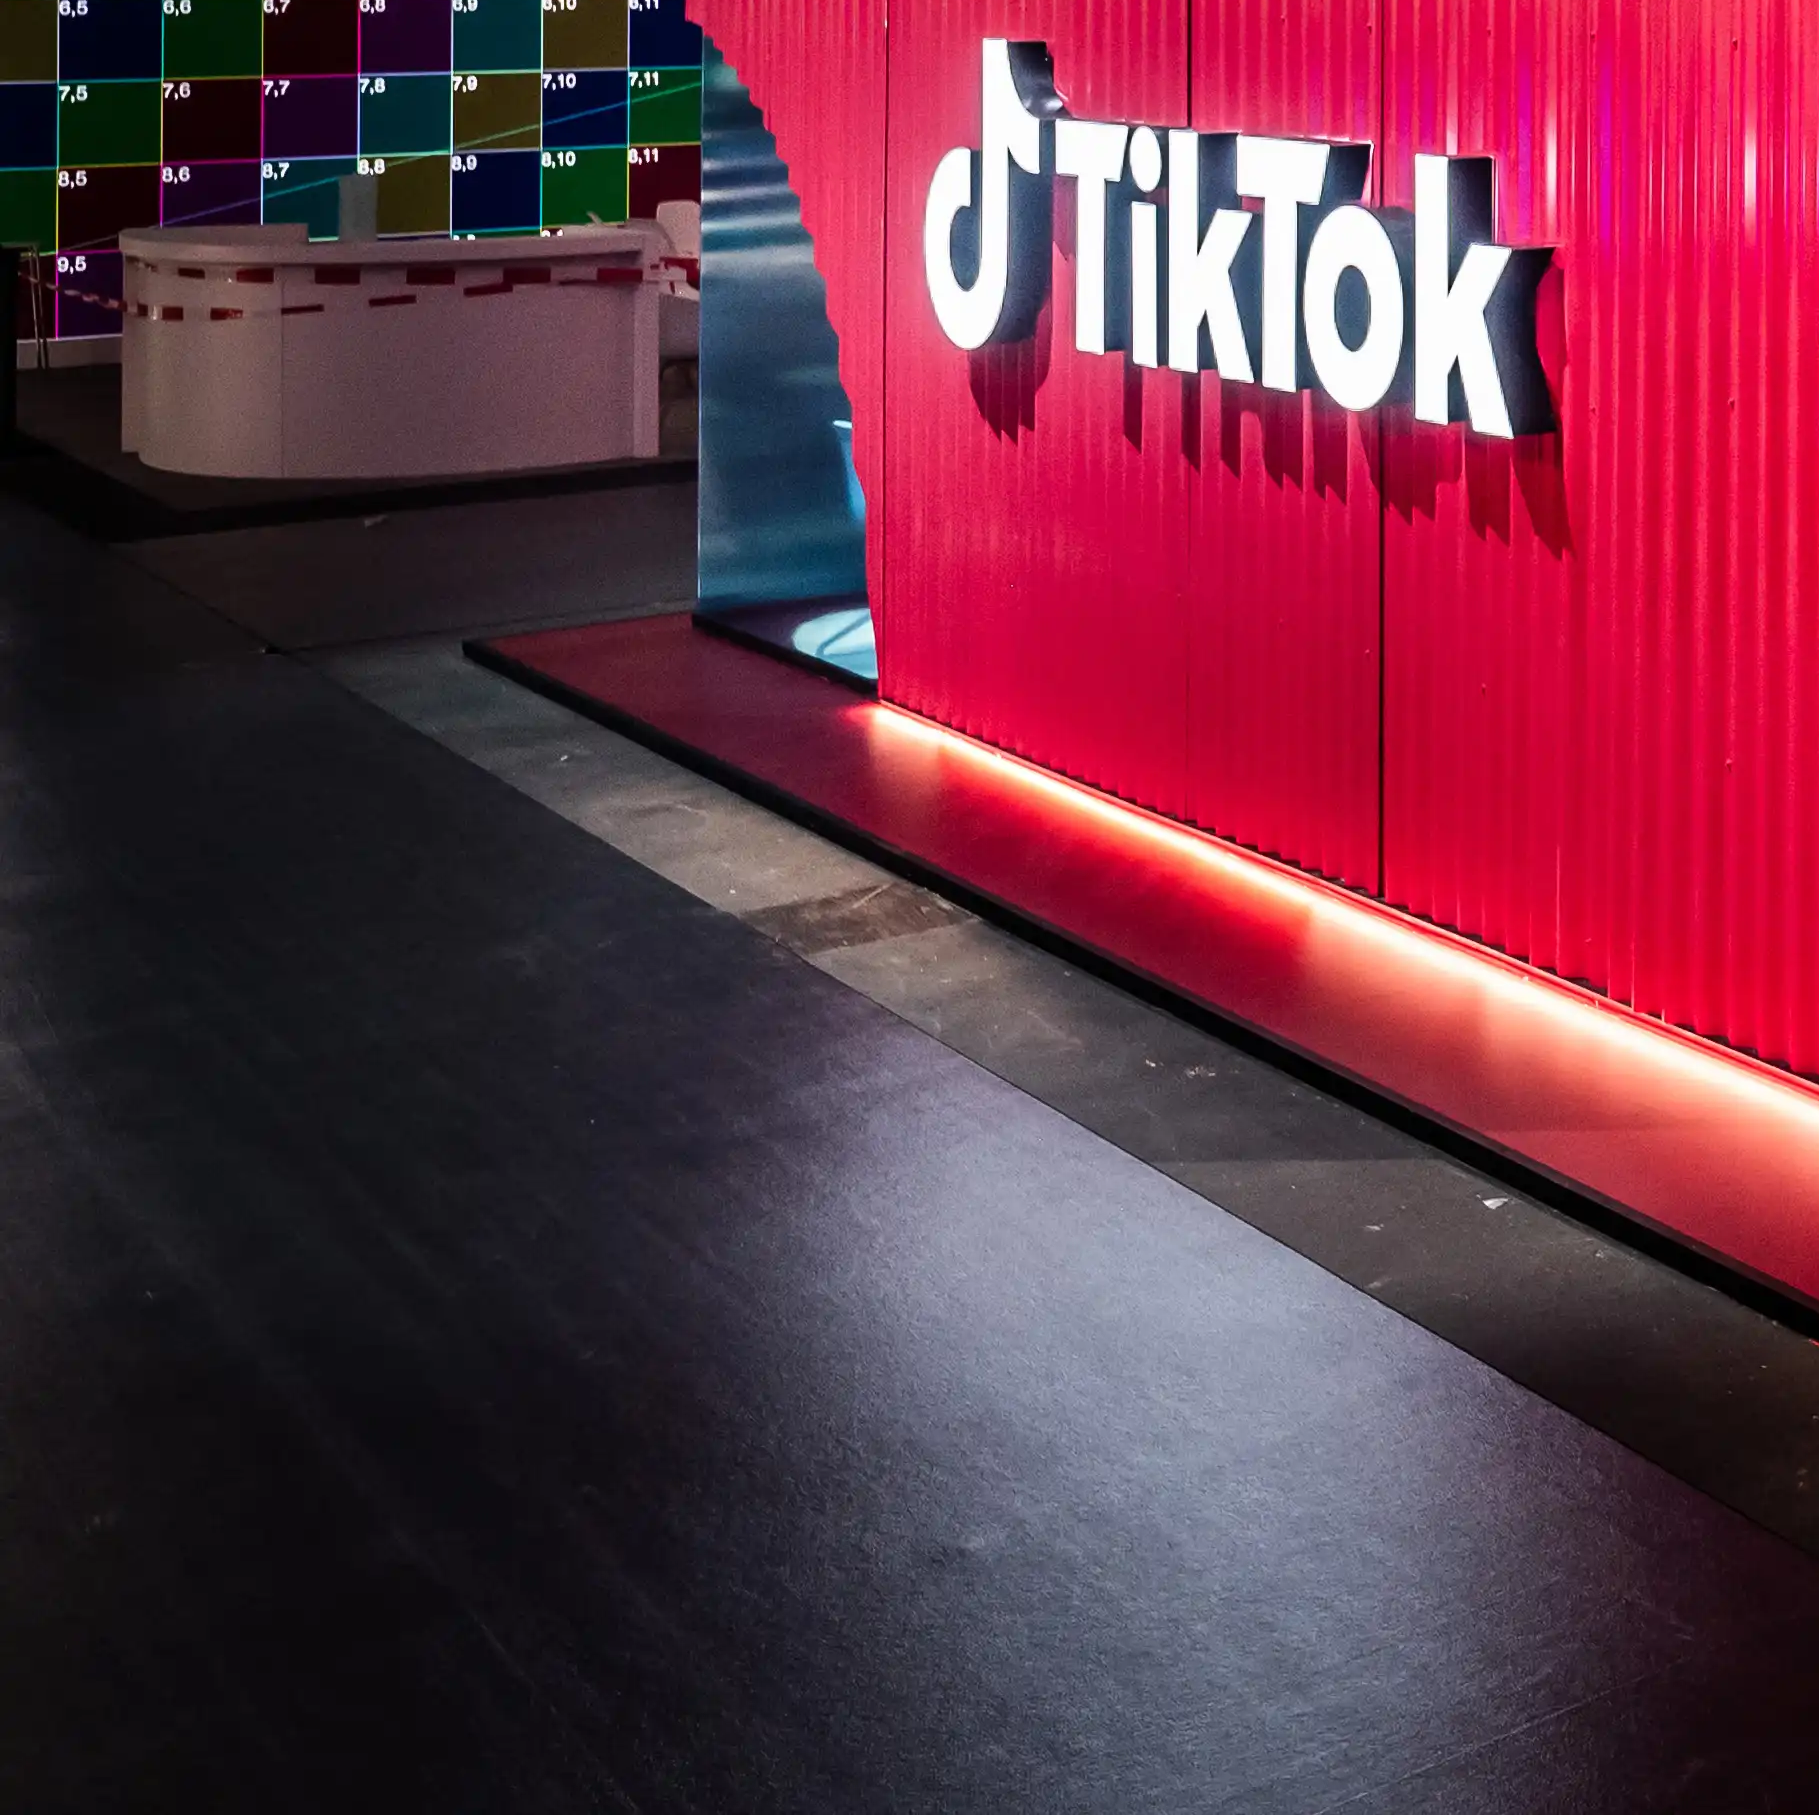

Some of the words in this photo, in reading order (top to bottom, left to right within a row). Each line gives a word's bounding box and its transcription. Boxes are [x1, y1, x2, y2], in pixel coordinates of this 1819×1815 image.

[59, 0, 88, 18] 6,5
[162, 0, 191, 16] 6,6
[358, 78, 385, 95] 7,8
[452, 75, 477, 92] 7,9
[541, 73, 576, 90] 7,10
[628, 70, 658, 87] 7,11
[58, 86, 87, 103] 7,5
[162, 83, 191, 100] 7,6
[263, 81, 289, 98] 7,7
[452, 155, 477, 172] 8,9
[540, 151, 576, 168] 8,10
[628, 147, 658, 164] 8,11
[161, 166, 190, 184] 8,6
[262, 163, 289, 180] 8,7
[358, 159, 385, 176] 8,8
[58, 172, 87, 188] 8,5
[57, 257, 86, 274] 9,5
[1055, 118, 1514, 440] TikTok
